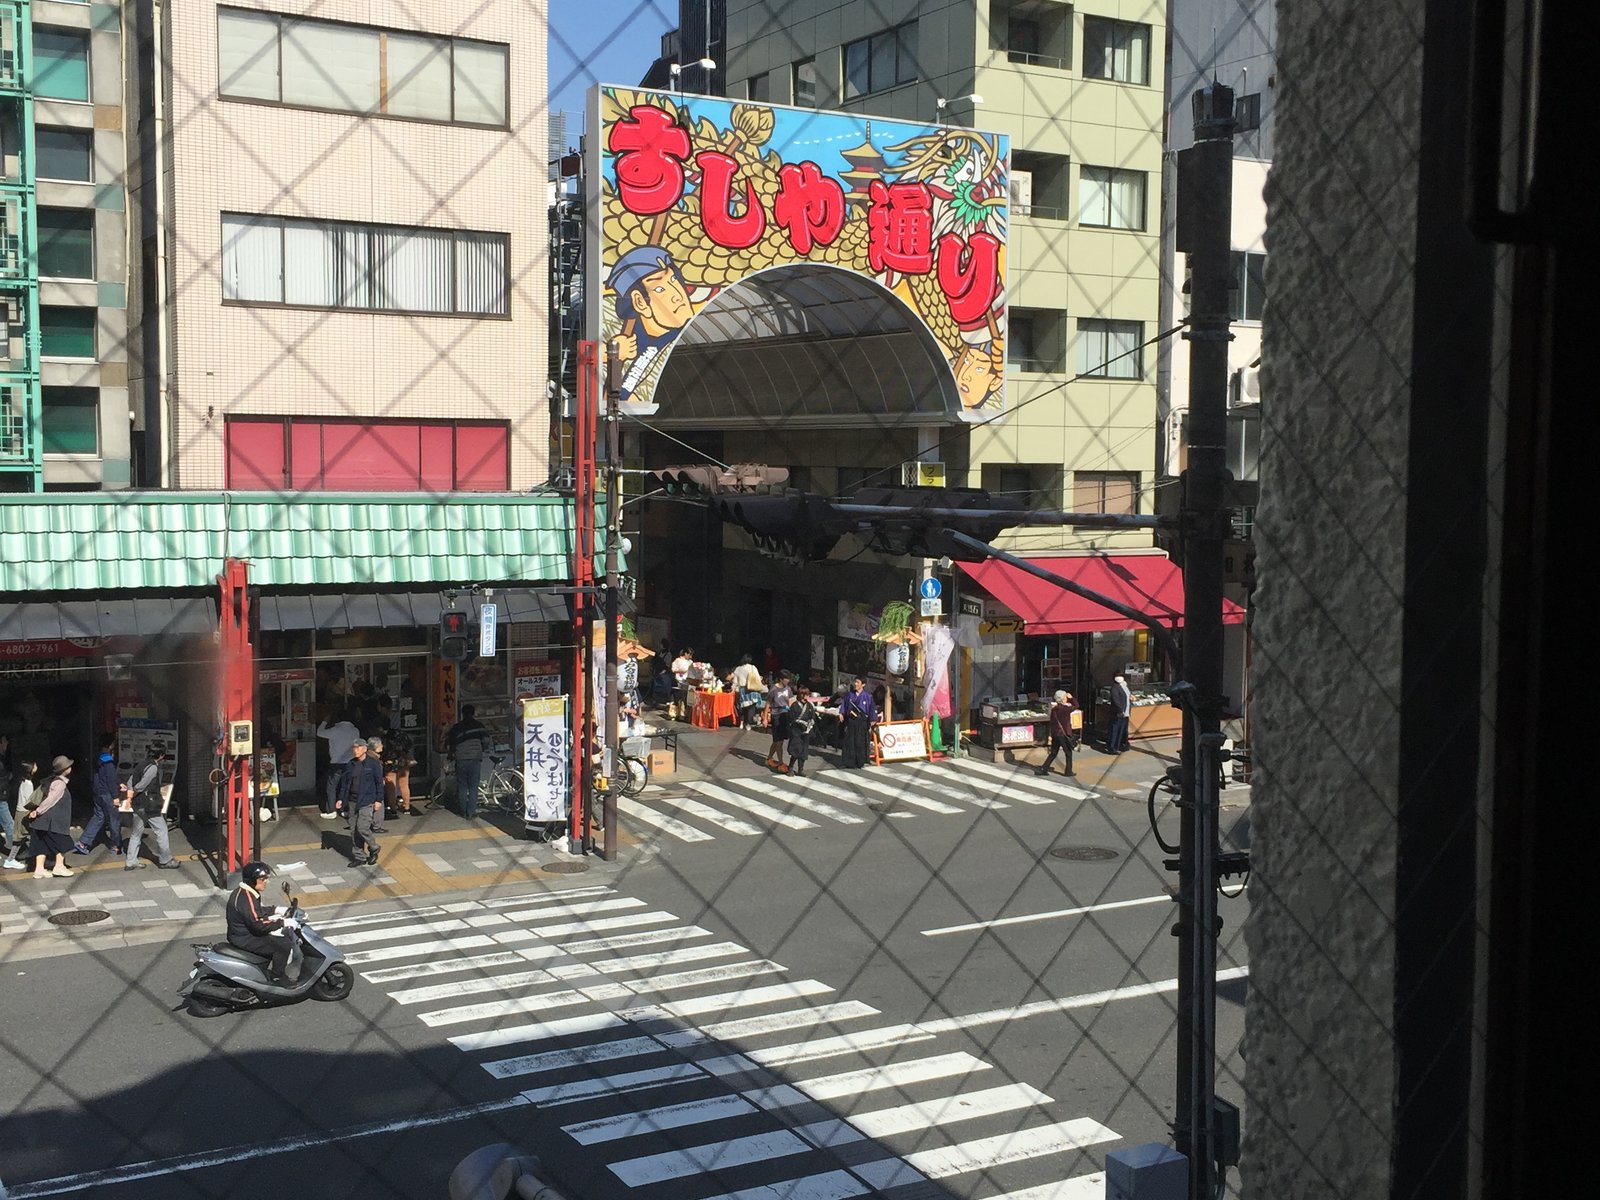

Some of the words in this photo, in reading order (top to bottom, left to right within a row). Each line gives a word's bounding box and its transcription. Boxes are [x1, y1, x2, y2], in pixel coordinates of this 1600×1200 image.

[0, 644, 58, 655] -6802-7961
[442, 665, 455, 708] てんや
